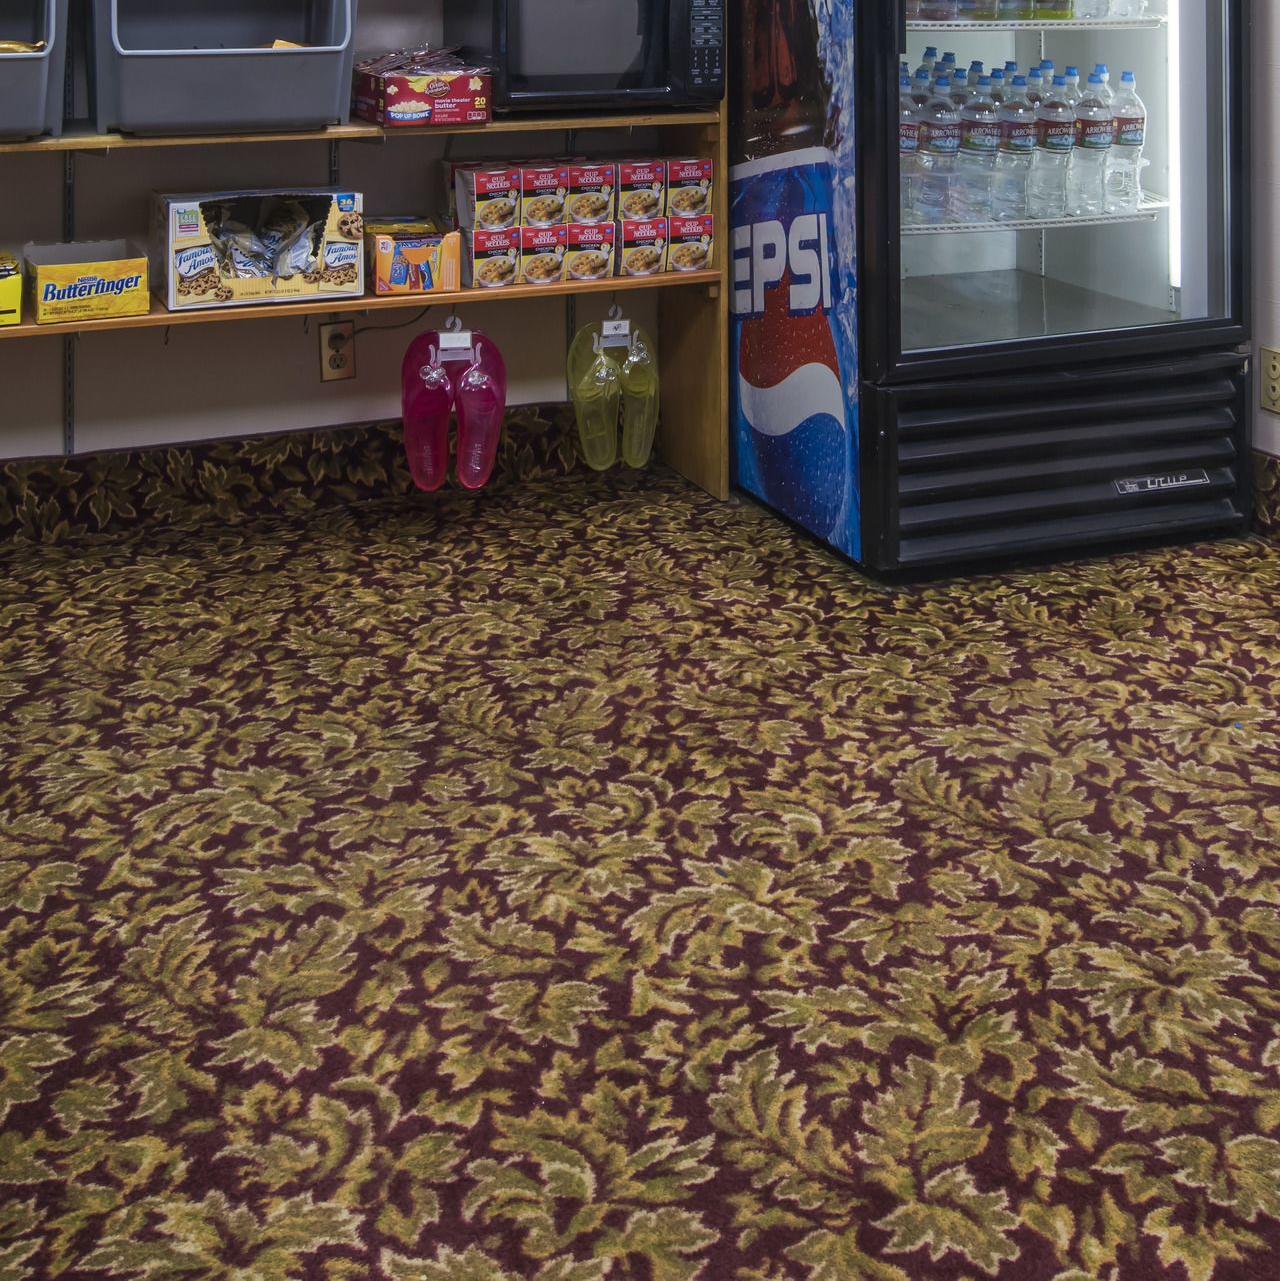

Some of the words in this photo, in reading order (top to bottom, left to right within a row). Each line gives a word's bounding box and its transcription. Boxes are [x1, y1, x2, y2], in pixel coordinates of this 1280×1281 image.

[474, 97, 486, 105] 20
[340, 198, 353, 206] 36
[174, 245, 214, 264] Famous
[325, 244, 359, 258] Famous
[333, 252, 357, 264] Amos
[188, 255, 216, 270] Amos
[42, 274, 143, 302] Butterfinger
